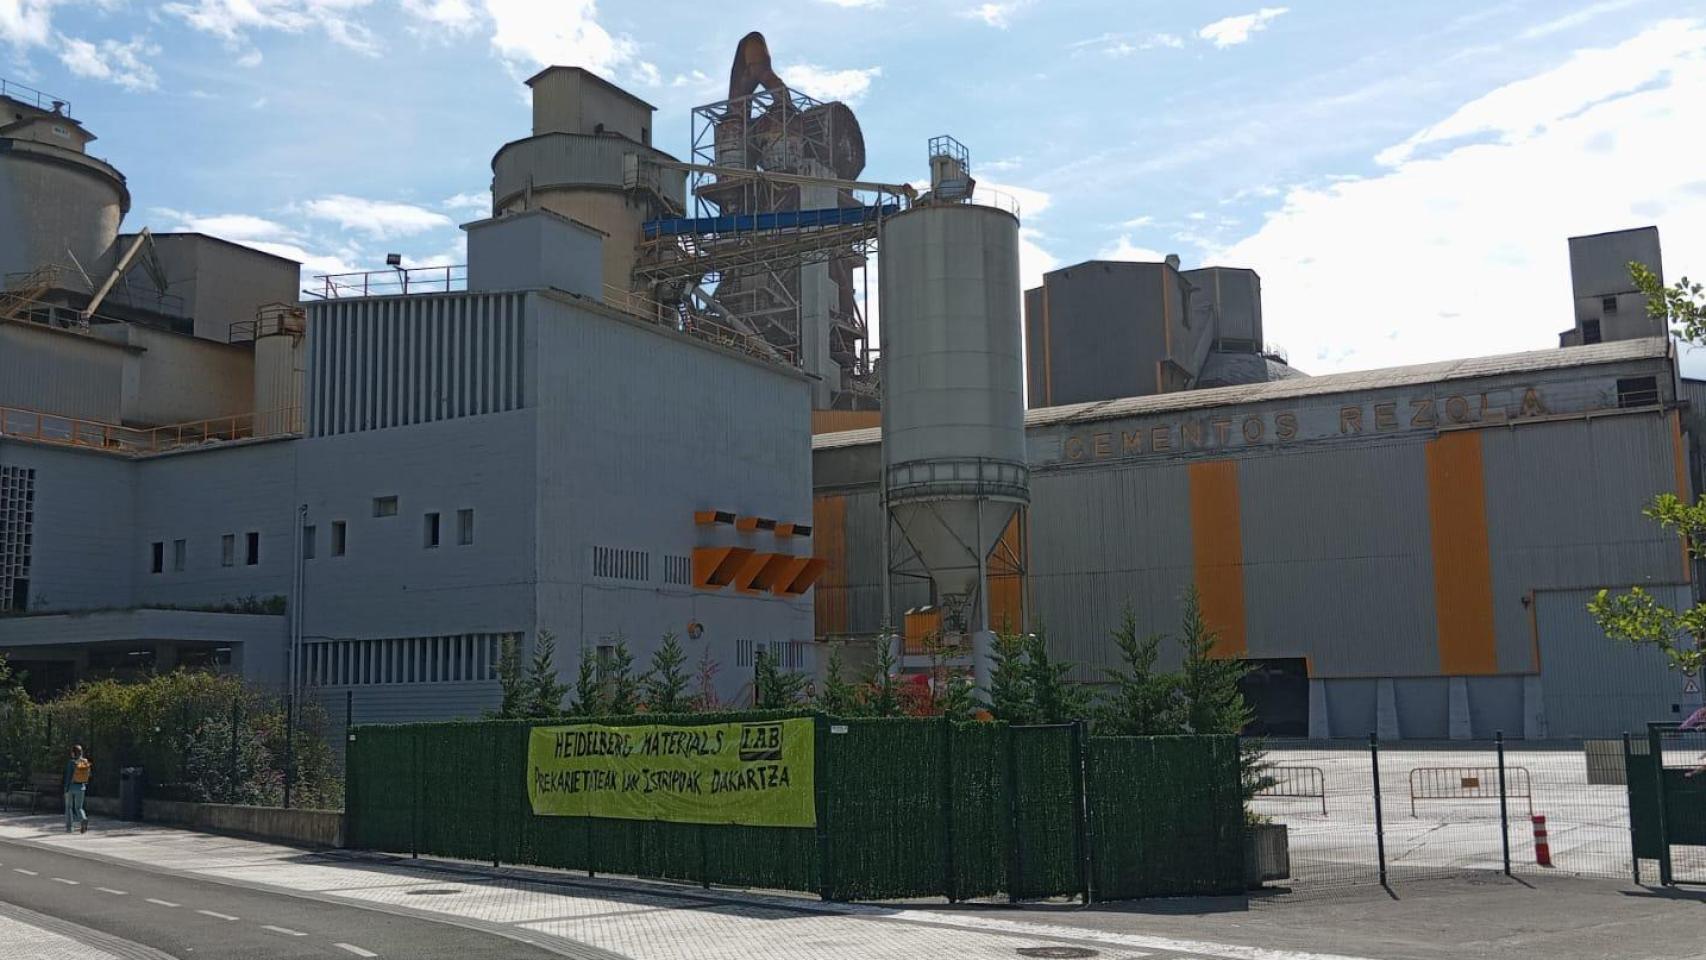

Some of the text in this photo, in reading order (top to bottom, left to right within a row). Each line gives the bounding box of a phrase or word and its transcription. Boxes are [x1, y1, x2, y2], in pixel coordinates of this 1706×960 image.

[1064, 388, 1545, 460] CEMENTOS REZOLA
[555, 730, 724, 758] HEIDELBERG MATERIALS
[741, 727, 780, 749] LAB
[710, 764, 791, 794] DAKARTZA
